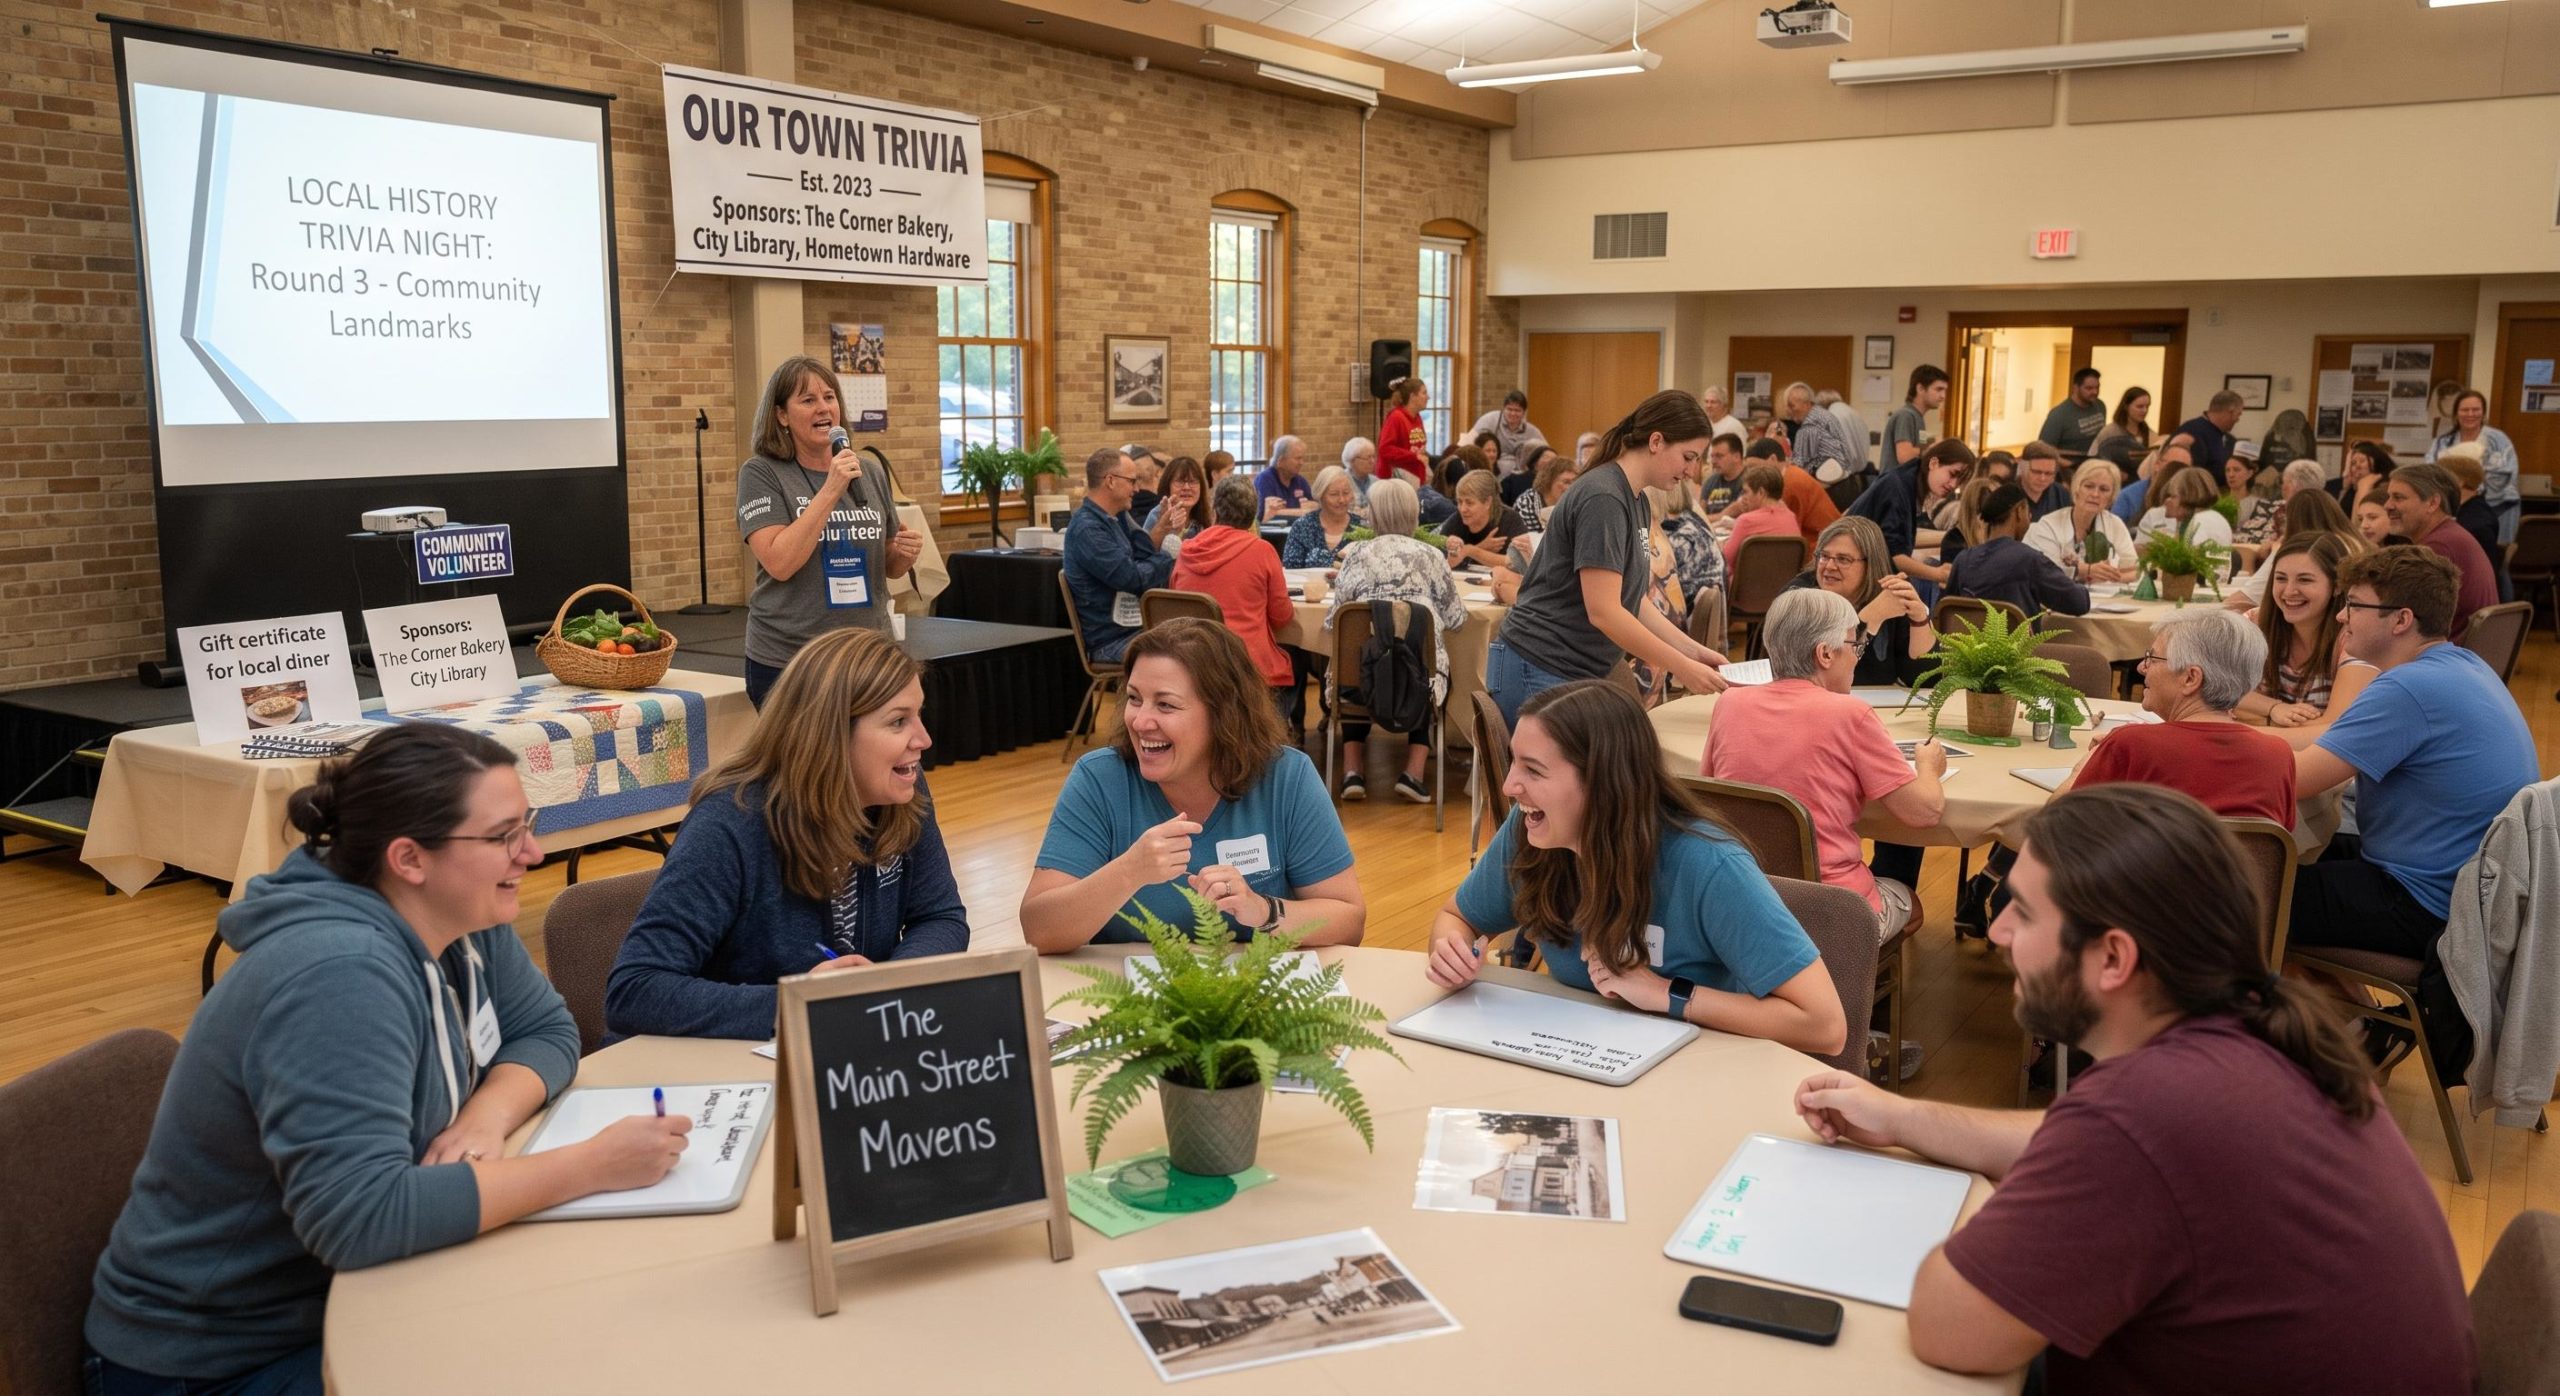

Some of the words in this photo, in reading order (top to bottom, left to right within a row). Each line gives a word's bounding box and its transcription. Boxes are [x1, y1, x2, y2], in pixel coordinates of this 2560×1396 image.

[683, 93, 761, 149] OUR
[767, 106, 865, 162] TOWN
[873, 123, 969, 175] TRIVIA
[288, 176, 379, 211] LOCAL
[388, 186, 498, 220] HISTORY
[800, 170, 828, 193] Est.
[833, 174, 872, 197] 2023
[712, 196, 801, 226] Sponsors:
[805, 205, 835, 228] The
[839, 208, 893, 234] Corner
[897, 214, 954, 243] Bakery,
[299, 221, 395, 255] TRIVIA
[403, 229, 492, 260] NIGHT:
[693, 227, 729, 257] City
[734, 231, 801, 262] Library,
[805, 237, 893, 265] Hometown
[898, 245, 971, 269] Hardware
[2038, 229, 2072, 255] EXIT
[251, 262, 344, 293] Round
[353, 269, 369, 295] 3
[396, 271, 541, 308] Community
[330, 310, 473, 339] Landmarks
[796, 505, 881, 525] Cmunity
[421, 531, 505, 556] COMMUNITY
[818, 525, 882, 541] lunteer
[427, 552, 506, 577] VOLUNTEER
[199, 633, 234, 653] Gift
[238, 626, 326, 649] certificate
[400, 620, 472, 642] Sponsors:
[206, 663, 234, 681] for
[238, 655, 282, 677] local
[286, 653, 330, 670] diner
[379, 651, 408, 668] The
[411, 646, 457, 663] Corner
[460, 638, 505, 656] Bakery
[410, 671, 437, 688] City
[440, 665, 487, 683] Library
[866, 999, 943, 1042] The
[827, 1063, 910, 1110] Main
[918, 1038, 1016, 1093] Street
[859, 1117, 996, 1173] Mavens
